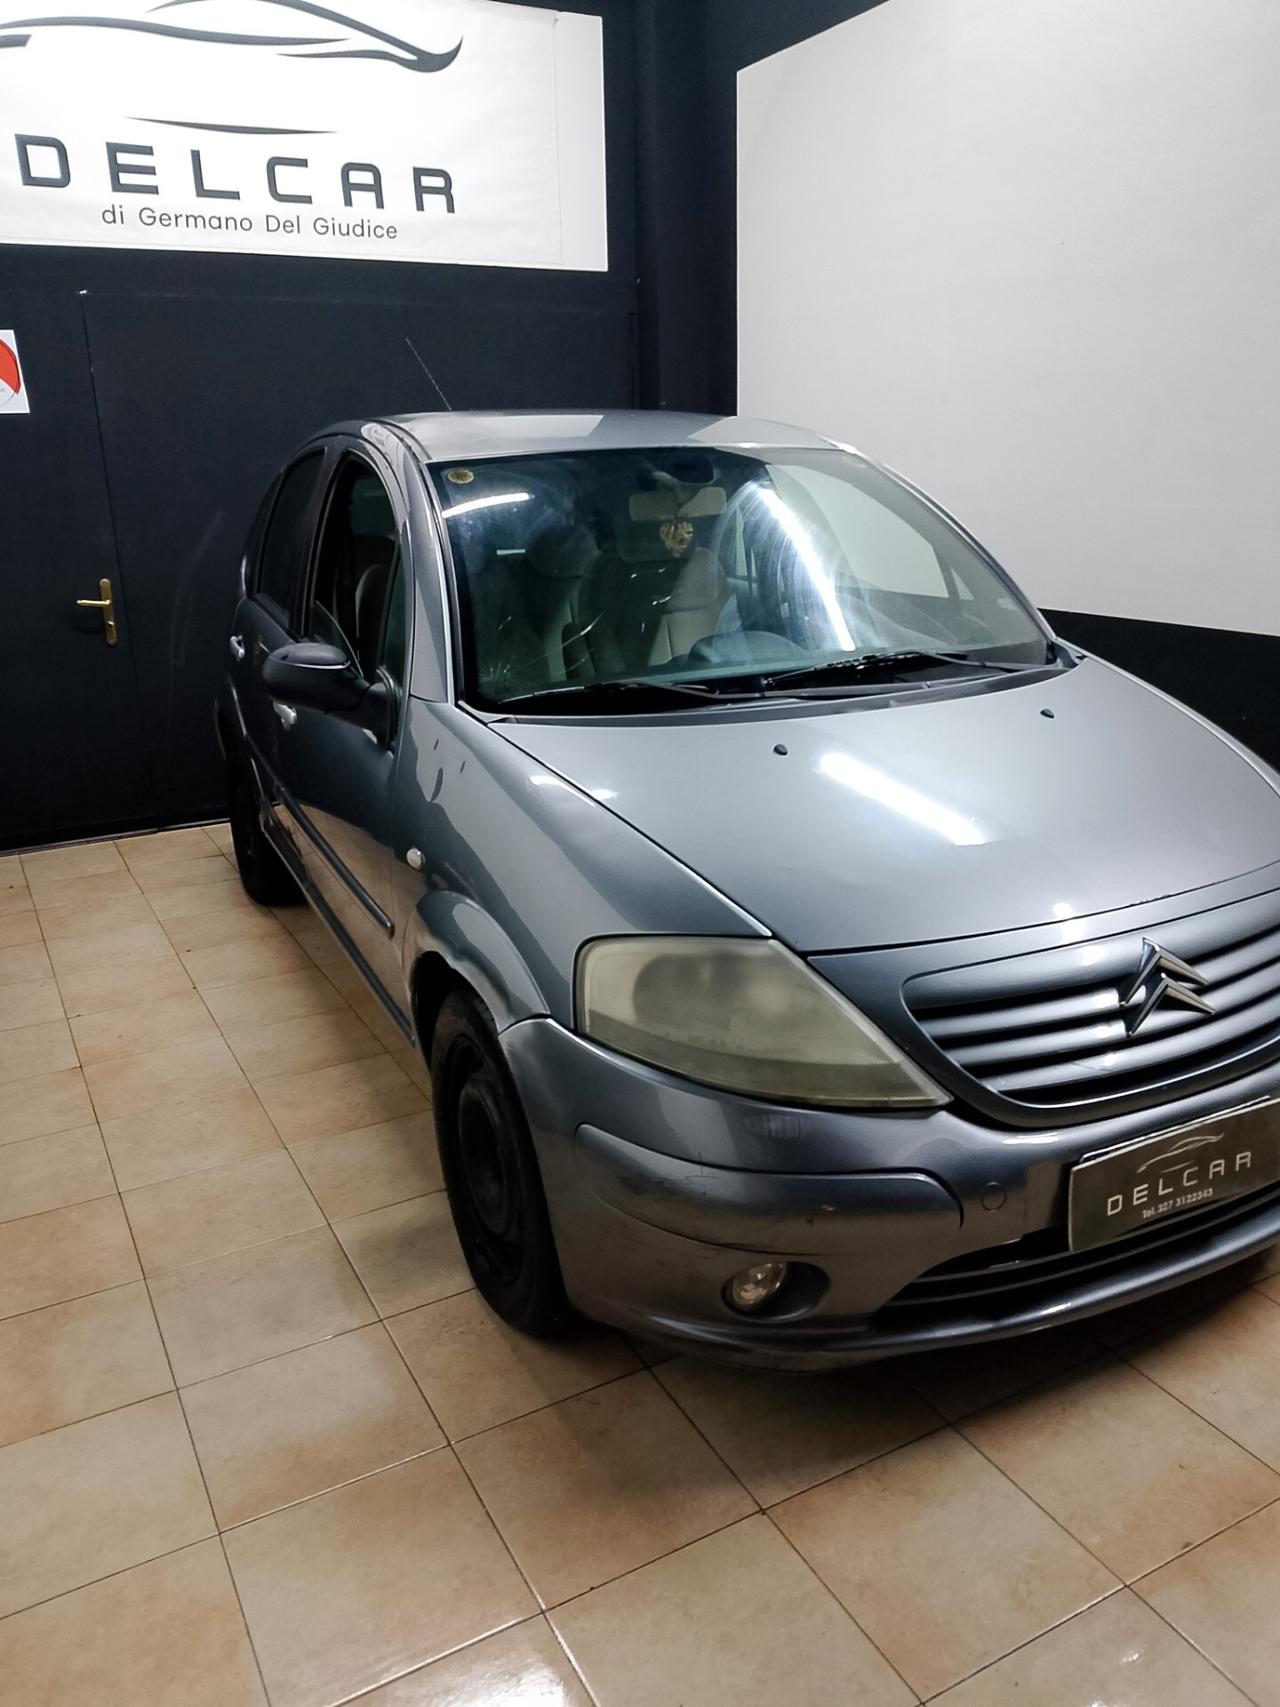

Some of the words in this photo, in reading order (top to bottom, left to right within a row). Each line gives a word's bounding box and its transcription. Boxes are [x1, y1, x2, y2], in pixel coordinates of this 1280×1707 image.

[14, 133, 456, 214] DELCAR
[101, 205, 125, 226] di
[139, 206, 253, 233] Germano
[265, 215, 301, 235] Del
[313, 216, 398, 240] Giudice
[1107, 1151, 1251, 1216] DELCAR
[1157, 1200, 1173, 1213] 327
